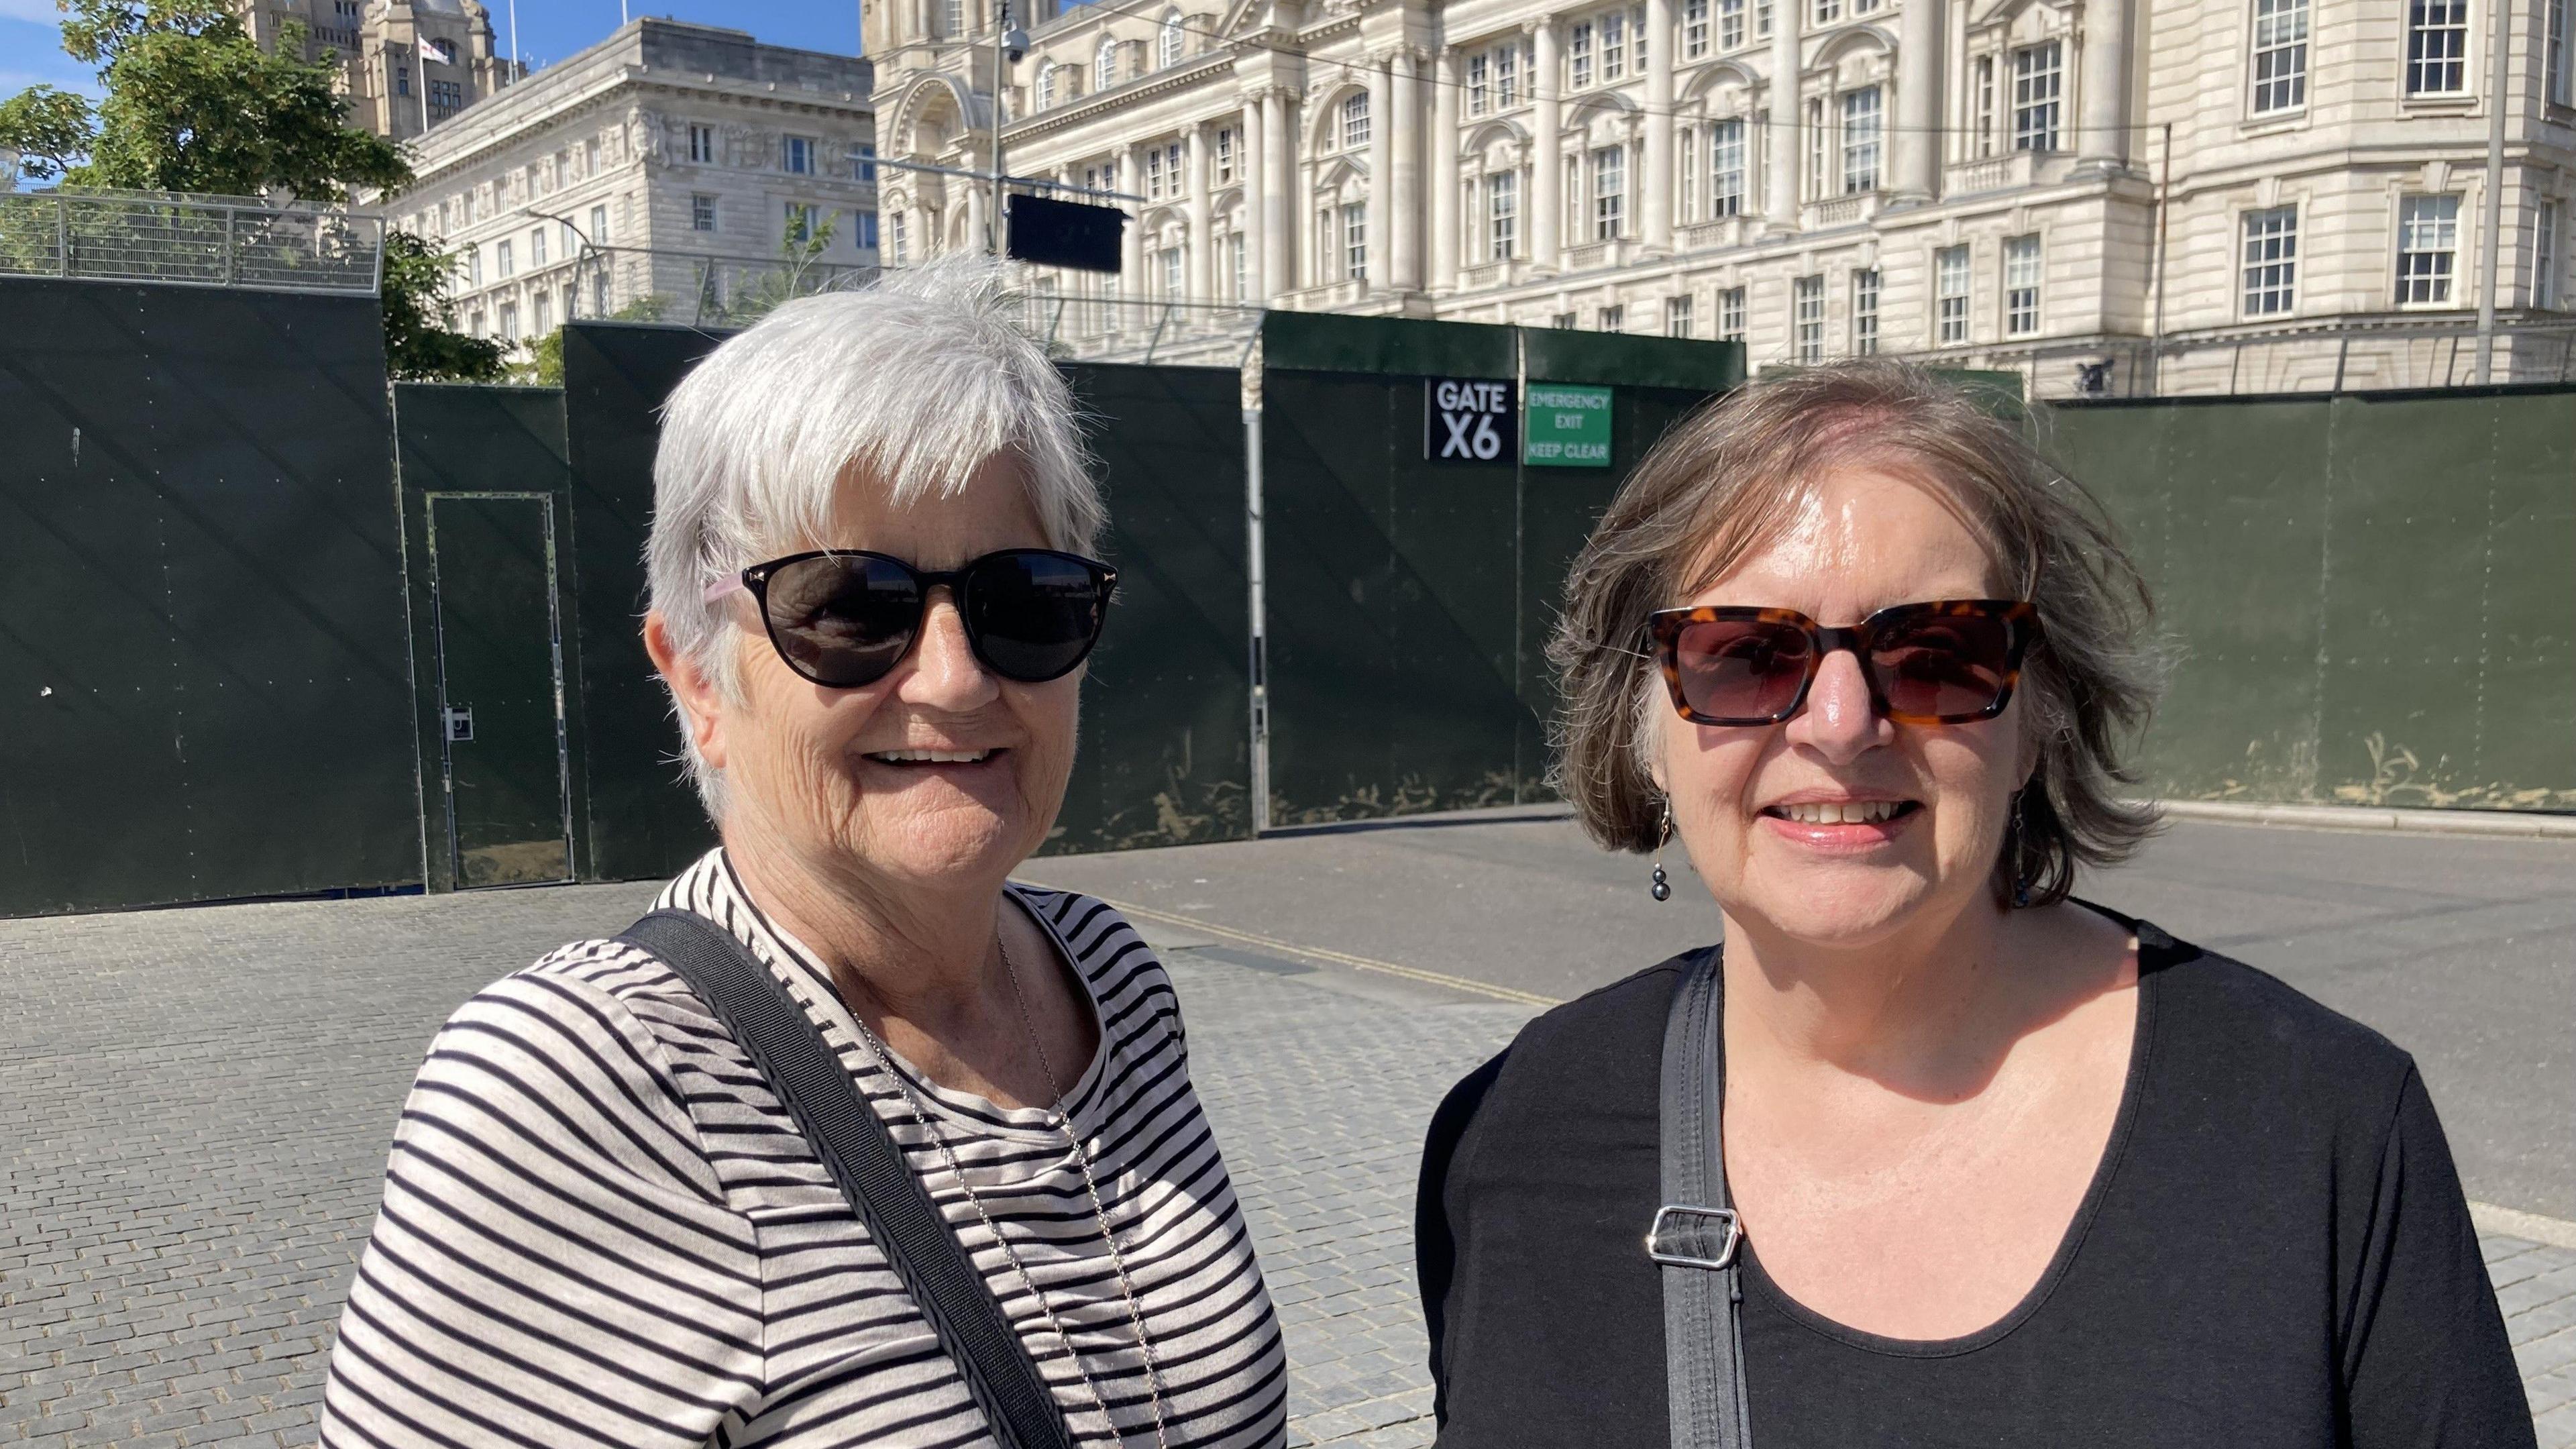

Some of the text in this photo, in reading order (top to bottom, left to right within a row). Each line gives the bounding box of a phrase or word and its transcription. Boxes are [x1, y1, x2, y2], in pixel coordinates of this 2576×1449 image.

[1436, 381, 1507, 413] GATE
[1529, 392, 1609, 409] EMERGENCY
[1554, 413, 1584, 429] EXIT
[1441, 413, 1501, 460] X6
[1528, 442, 1607, 458] KEEP CLEAR
